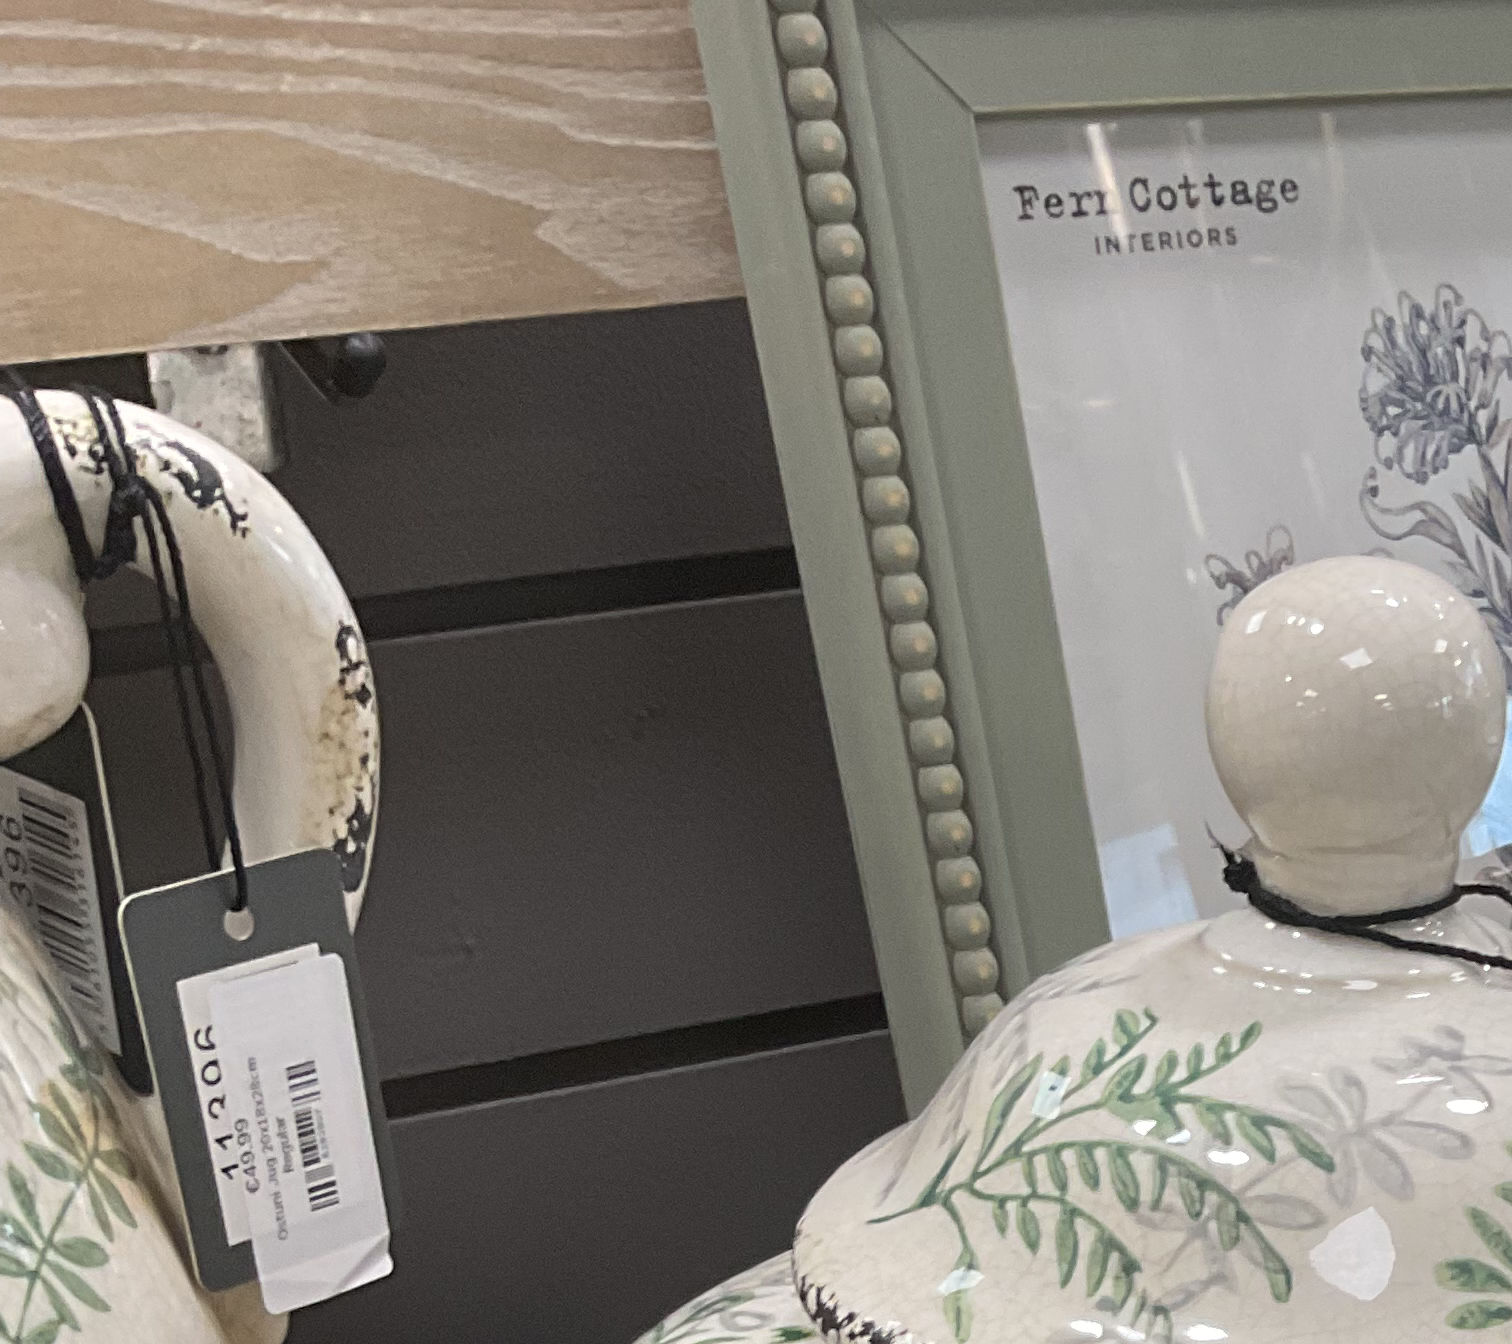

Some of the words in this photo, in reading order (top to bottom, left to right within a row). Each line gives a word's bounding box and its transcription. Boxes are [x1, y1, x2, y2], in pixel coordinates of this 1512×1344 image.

[1129, 172, 1299, 214] Cottage
[1094, 225, 1239, 256] INTERIORS
[234, 1118, 260, 1193] €49.99
[276, 1116, 294, 1173] Regular
[266, 1157, 280, 1187] Jug
